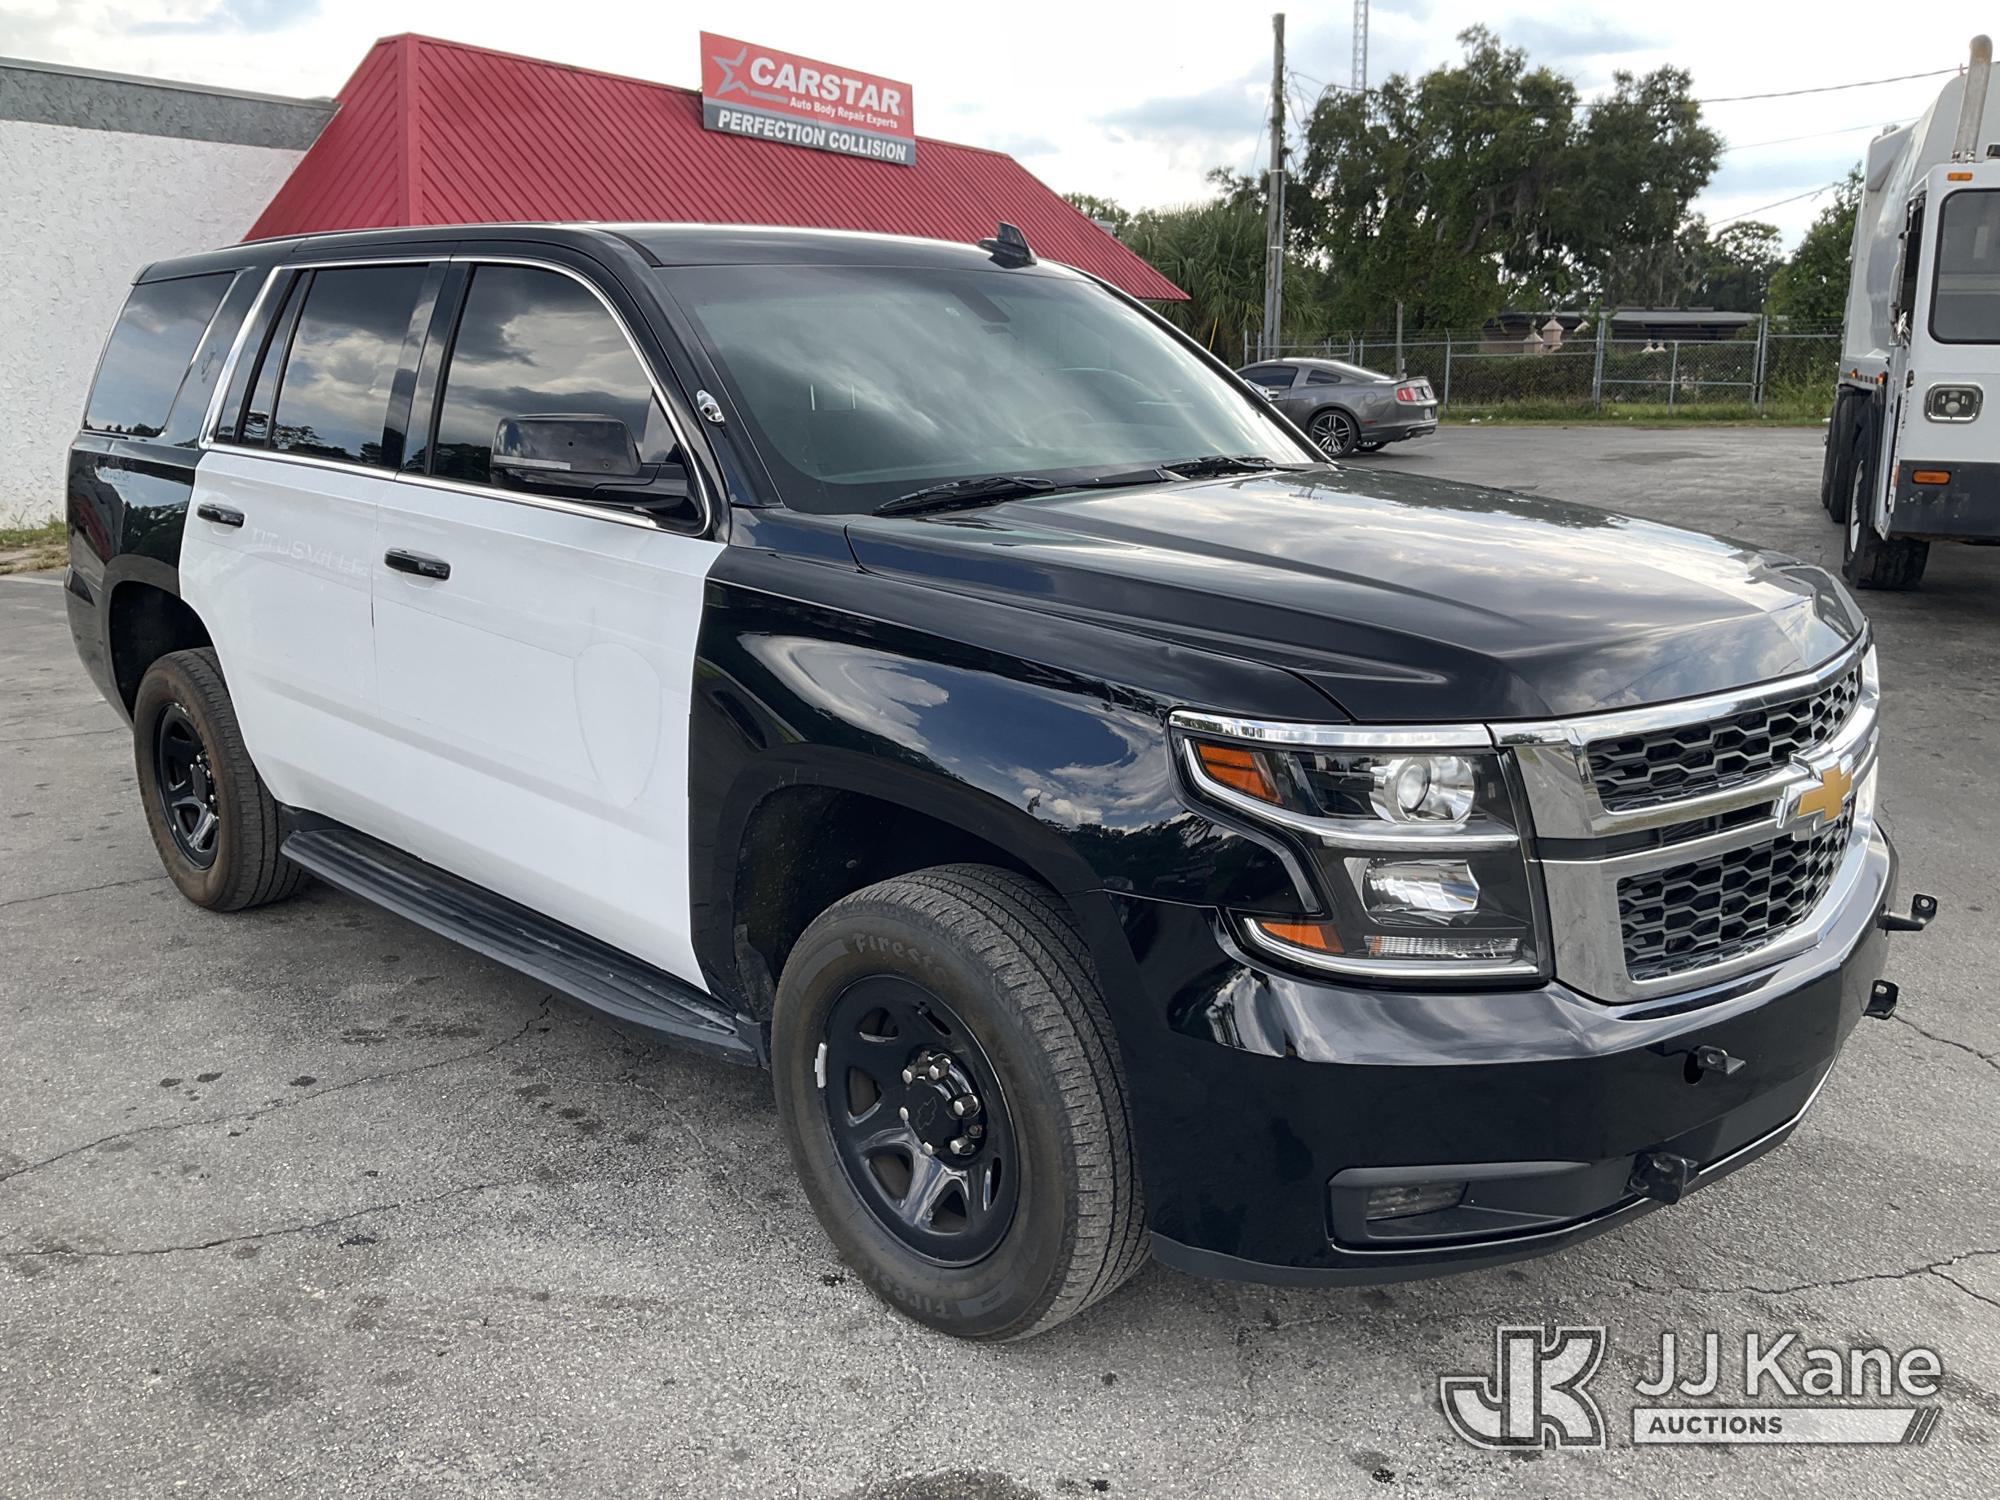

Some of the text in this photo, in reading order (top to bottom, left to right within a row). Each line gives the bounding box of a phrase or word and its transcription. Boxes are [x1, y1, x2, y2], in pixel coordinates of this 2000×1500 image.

[750, 57, 901, 116] CARSTAR
[790, 96, 898, 129] Auto Body Repair Experts
[718, 109, 906, 161] PERFECTION COLLISION
